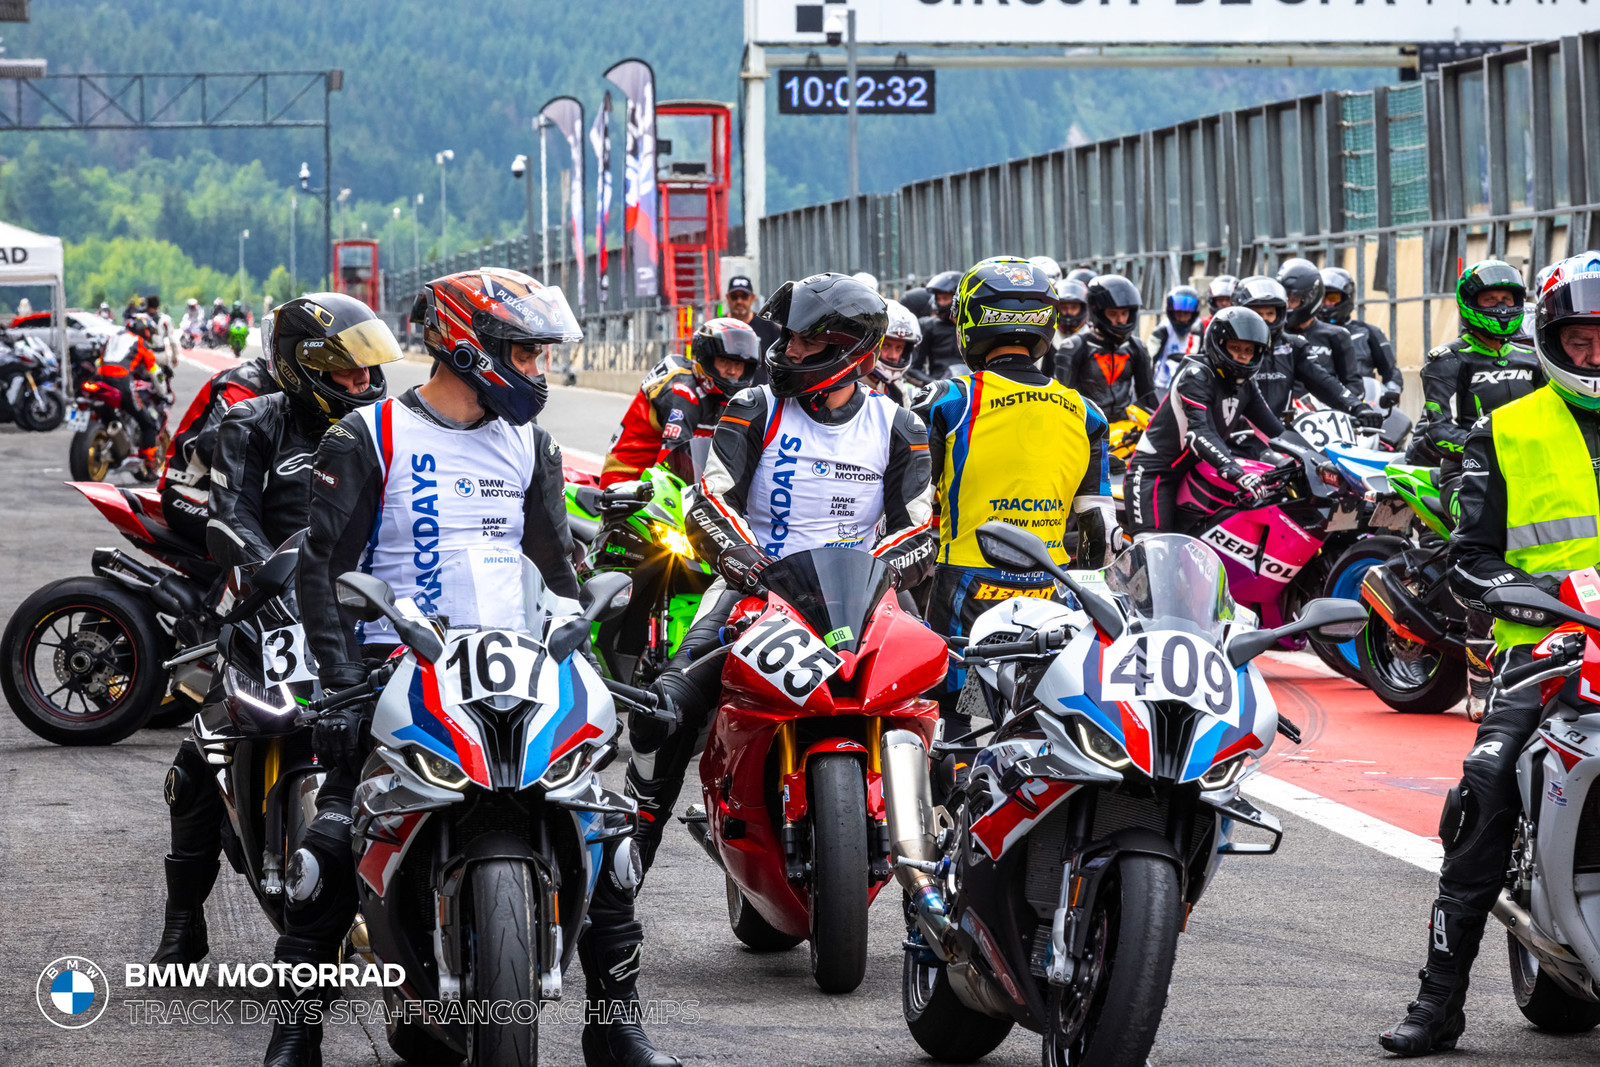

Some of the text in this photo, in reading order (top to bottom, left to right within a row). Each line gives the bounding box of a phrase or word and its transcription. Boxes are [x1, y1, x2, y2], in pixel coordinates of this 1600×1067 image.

[785, 77, 928, 107] 10:02:32
[982, 308, 1050, 325] KENNY
[836, 463, 861, 471] BMW
[478, 479, 504, 488] BMW
[480, 489, 524, 500] MOTORRA
[764, 433, 803, 560] ACKDAYS
[832, 496, 855, 504] MAKE
[411, 453, 443, 618] RACKDAYS
[832, 630, 846, 642] DB
[446, 631, 548, 701] 167
[739, 617, 843, 697] 165
[1110, 634, 1233, 716] 409
